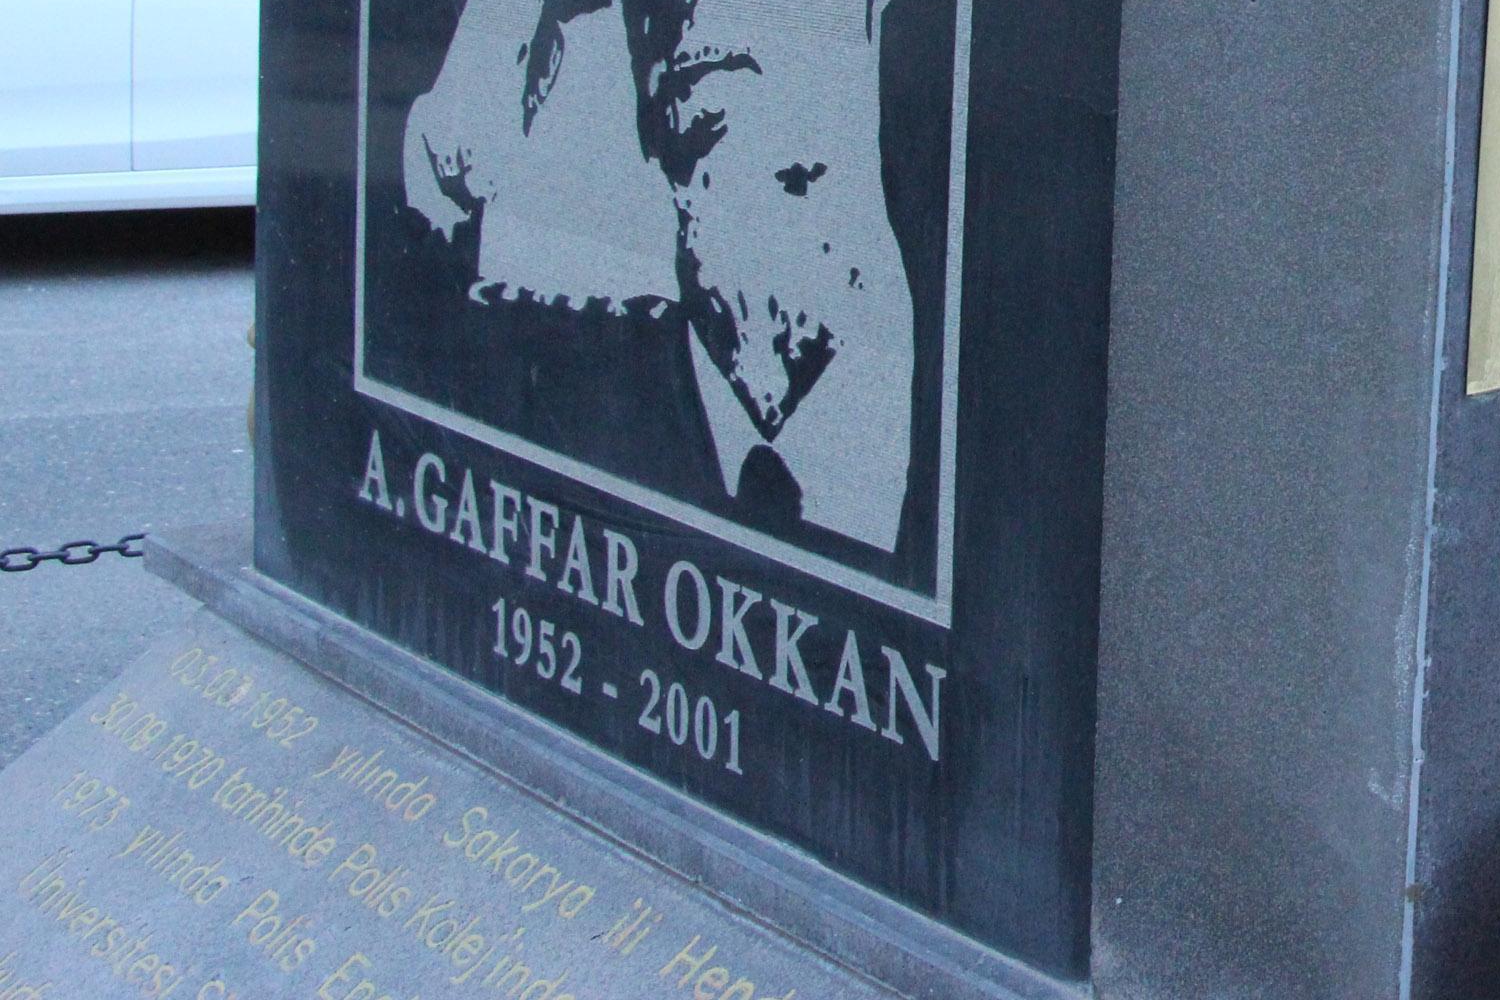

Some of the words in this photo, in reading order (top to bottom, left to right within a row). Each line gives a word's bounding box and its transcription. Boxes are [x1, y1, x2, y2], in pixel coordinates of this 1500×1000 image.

[492, 598, 584, 696] 1952
[638, 668, 745, 776] 2001
[663, 558, 948, 762] OKKAN
[211, 765, 338, 868] tarihinde
[327, 841, 412, 919] Polis
[443, 805, 597, 920] Sakarya
